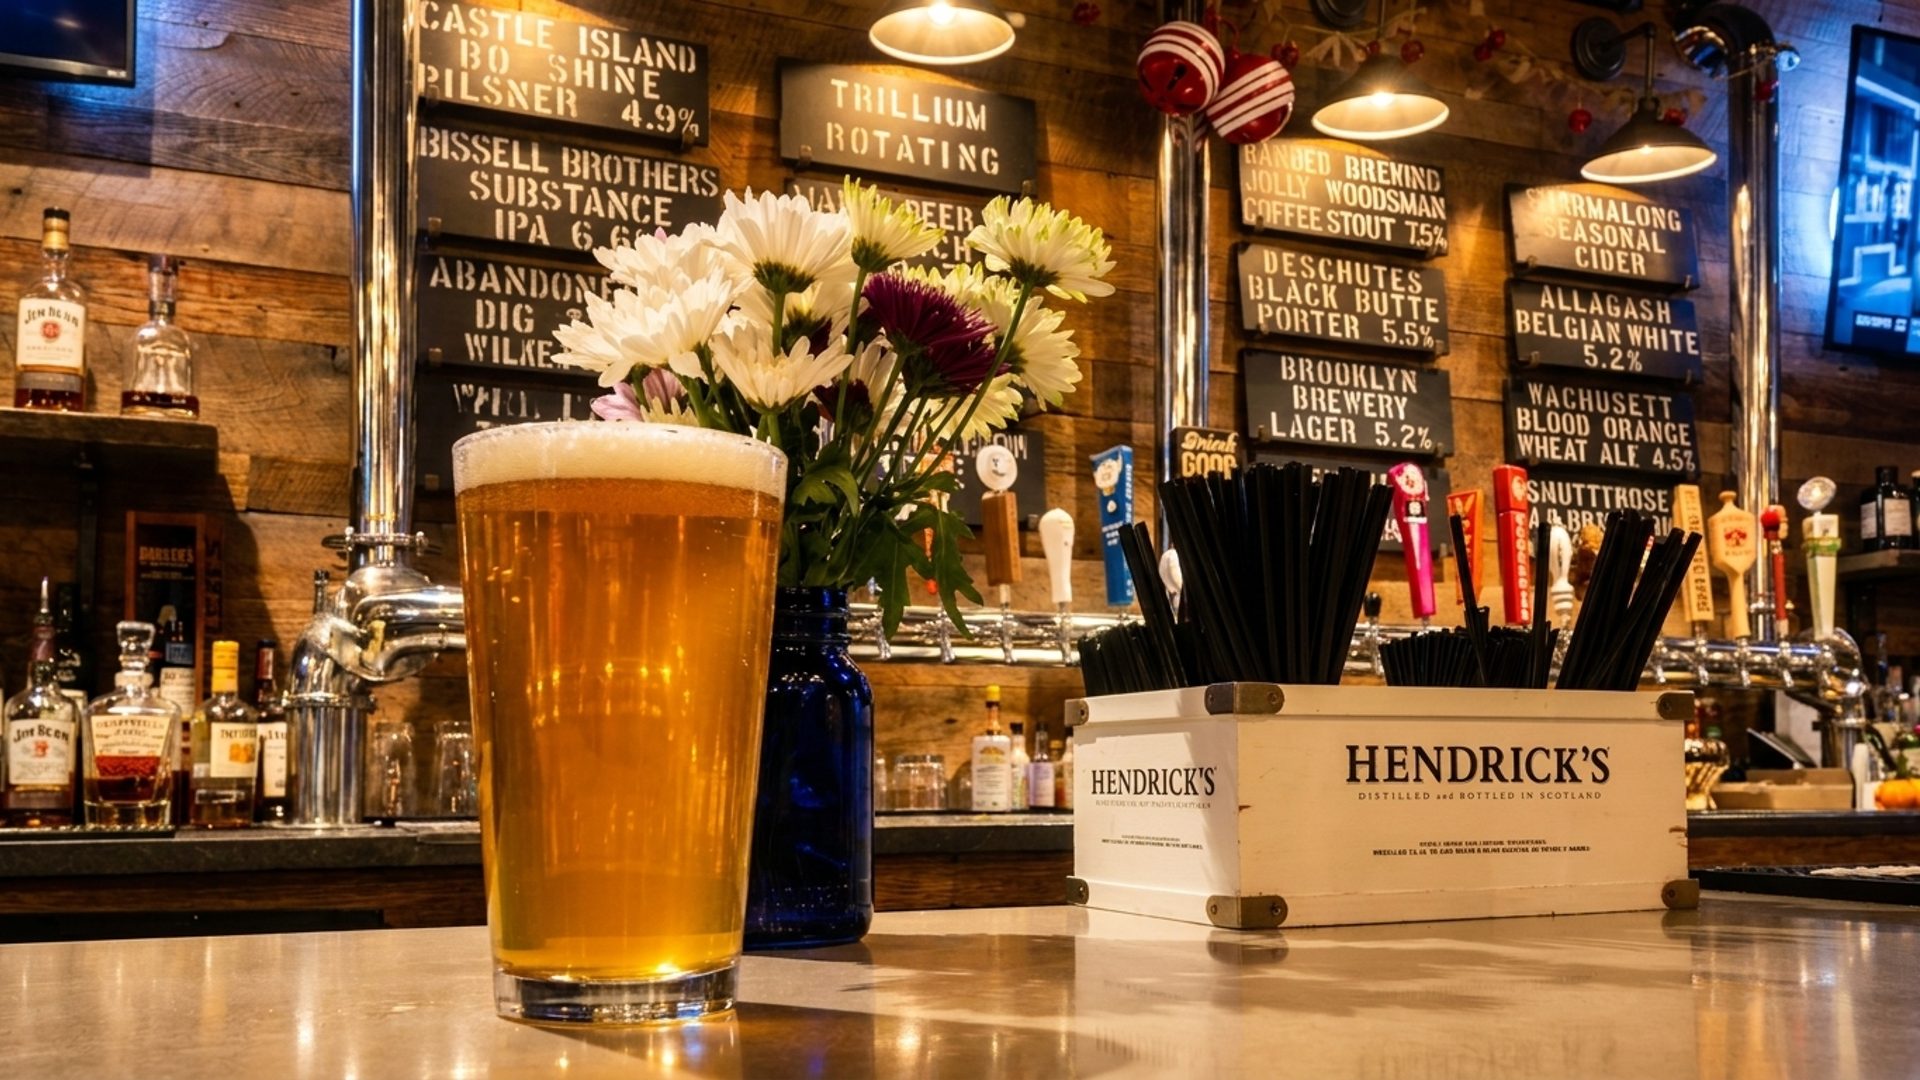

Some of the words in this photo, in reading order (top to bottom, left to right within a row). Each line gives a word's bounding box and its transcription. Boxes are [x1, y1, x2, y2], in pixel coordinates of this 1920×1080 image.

[420, 1, 554, 49] CASTLE
[579, 26, 696, 73] ISLAND
[460, 39, 509, 74] BO
[549, 54, 660, 99] SHINE
[418, 63, 577, 117] PILSNER
[621, 100, 699, 137] 4.9%
[831, 79, 986, 131] TRILLIUM
[420, 126, 549, 174] BISSELL
[562, 147, 718, 197] BROTHERS
[827, 122, 999, 175] ROTATING
[469, 170, 672, 226] SUBSTANCE
[1245, 170, 1310, 199] JOLLY
[1325, 179, 1446, 219] WOODSMAN
[495, 209, 550, 245] IPA
[1244, 198, 1323, 231] COFFEE
[1327, 210, 1396, 241] STOUT
[1543, 216, 1666, 254] SEASONAL
[1263, 250, 1422, 294] DESCHUTES
[1575, 246, 1646, 275] CIDER
[429, 256, 633, 307] ABANDONE
[1248, 275, 1338, 309] BLACK
[1355, 289, 1440, 323] BUTTE
[476, 299, 534, 334] DIG
[1541, 285, 1671, 324] ALLAGASH
[1258, 303, 1360, 339] PORTER
[1382, 319, 1434, 348] 5.5%
[1516, 309, 1621, 344] BELGIAN
[1627, 324, 1699, 355] WHITE
[1281, 355, 1417, 393] BROOKLYN
[1584, 344, 1643, 371] 5.2%
[1293, 384, 1408, 420] BREWERY
[1528, 382, 1671, 418] WACHUSETT
[1270, 411, 1357, 444] LAGER
[1375, 421, 1432, 450] 5.2%
[1516, 407, 1590, 436] BLOOD
[1603, 416, 1691, 446] ORANGE
[1517, 433, 1587, 462] WHEAT
[1600, 442, 1640, 468] ALE
[1091, 767, 1217, 797] HENDRICK'S
[1346, 744, 1611, 784] HENDRICK'S
[1358, 791, 1431, 801] DISTILLED
[1436, 791, 1454, 801] and
[1459, 791, 1515, 801] BOTTLED
[1521, 791, 1534, 801] IN
[1539, 791, 1603, 801] SCOTLAND
